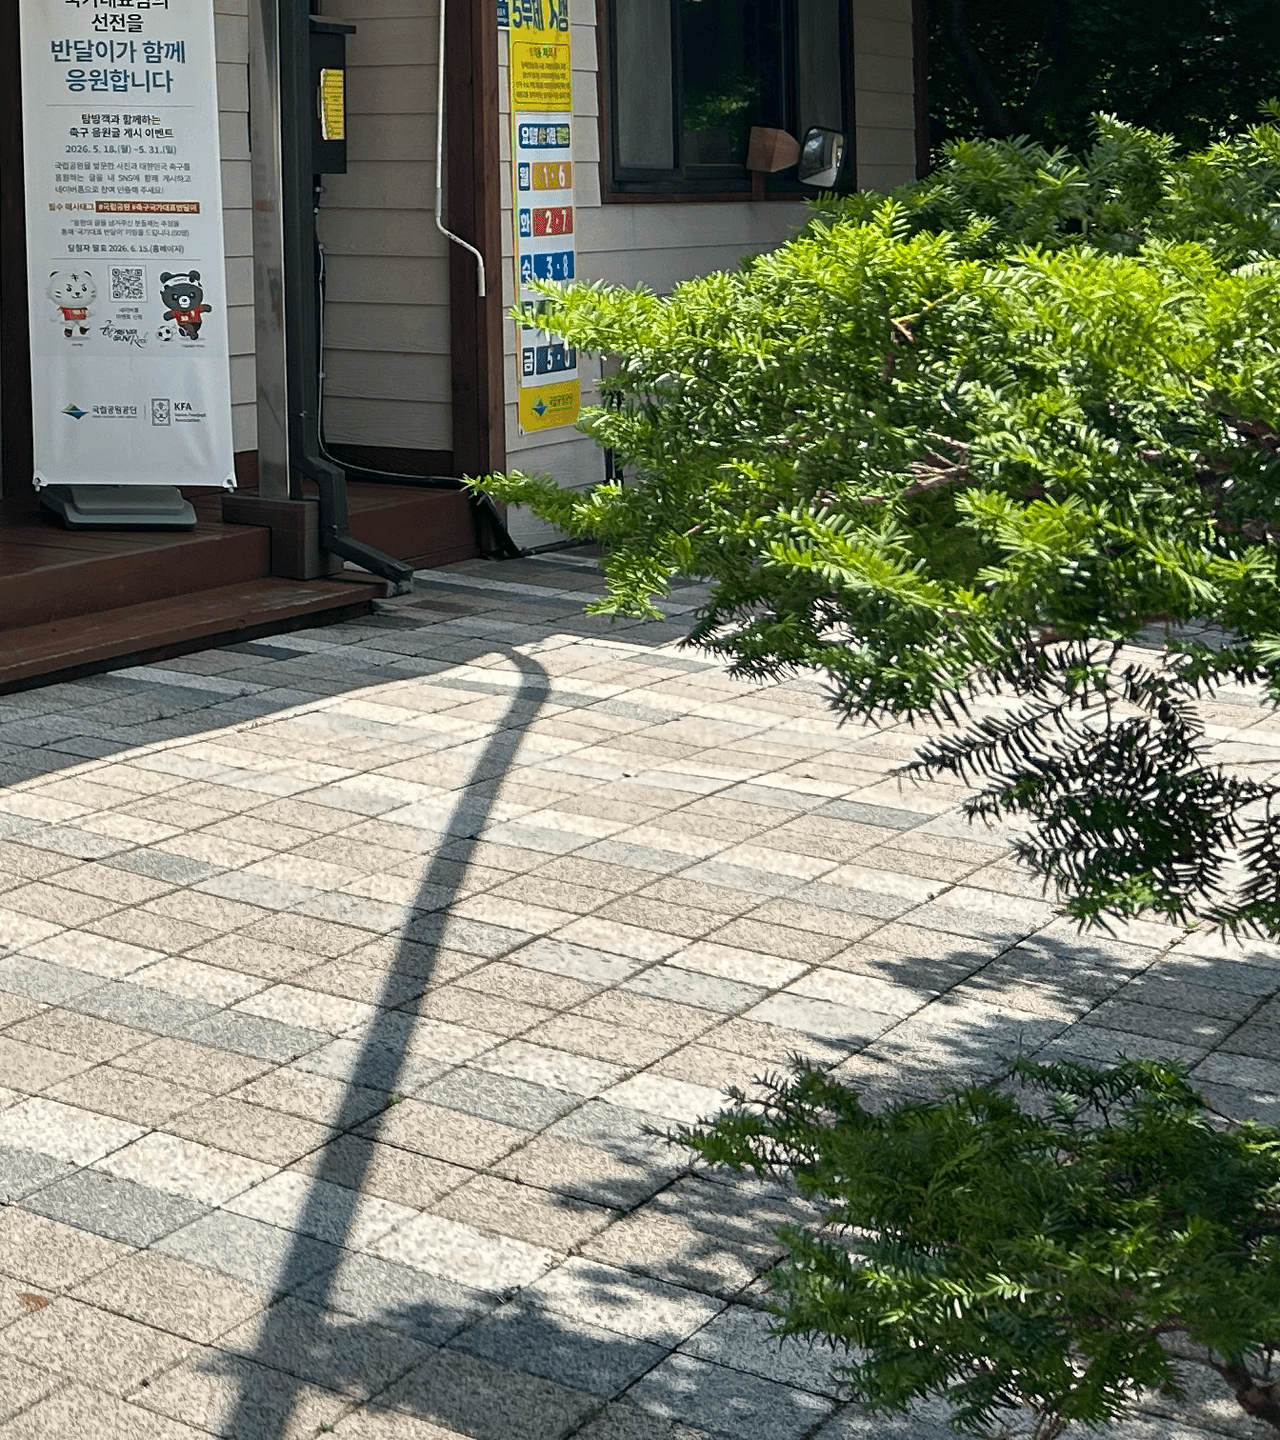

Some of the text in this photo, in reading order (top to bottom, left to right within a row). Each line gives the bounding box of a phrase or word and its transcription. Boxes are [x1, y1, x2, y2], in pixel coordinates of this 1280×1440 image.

[91, 13, 144, 33] 선전을
[50, 39, 186, 64] 반달이가 함께
[65, 68, 174, 94] 응원합니다
[123, 128, 142, 139] 게시
[145, 128, 175, 139] 이벤트
[65, 144, 92, 154] 2026.
[93, 144, 102, 154] 5.
[523, 351, 534, 372] 금
[173, 402, 193, 411] KFA
